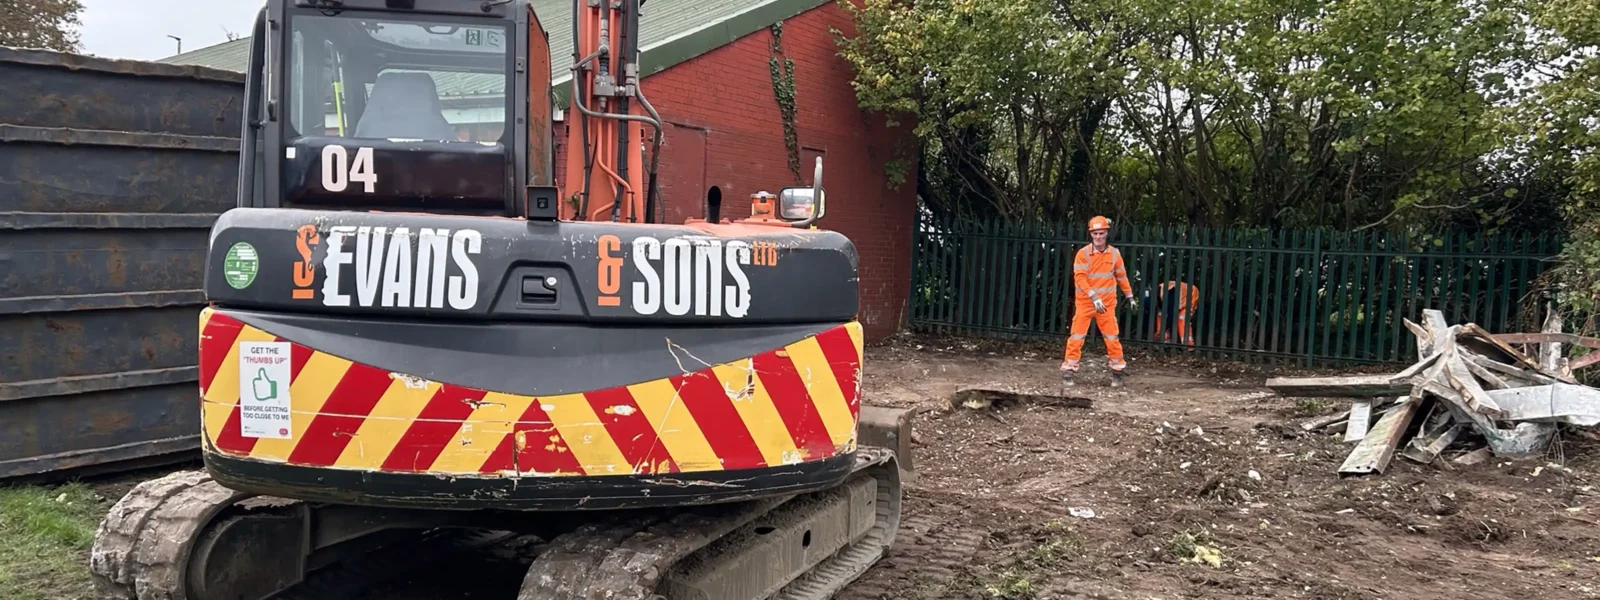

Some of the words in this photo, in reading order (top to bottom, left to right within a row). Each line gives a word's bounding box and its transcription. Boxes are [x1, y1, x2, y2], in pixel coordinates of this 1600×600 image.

[322, 145, 377, 193] 04
[293, 224, 320, 289] S
[322, 226, 482, 310] EVANS
[597, 235, 624, 295] &
[632, 236, 751, 318] SONS
[753, 241, 777, 266] LTD
